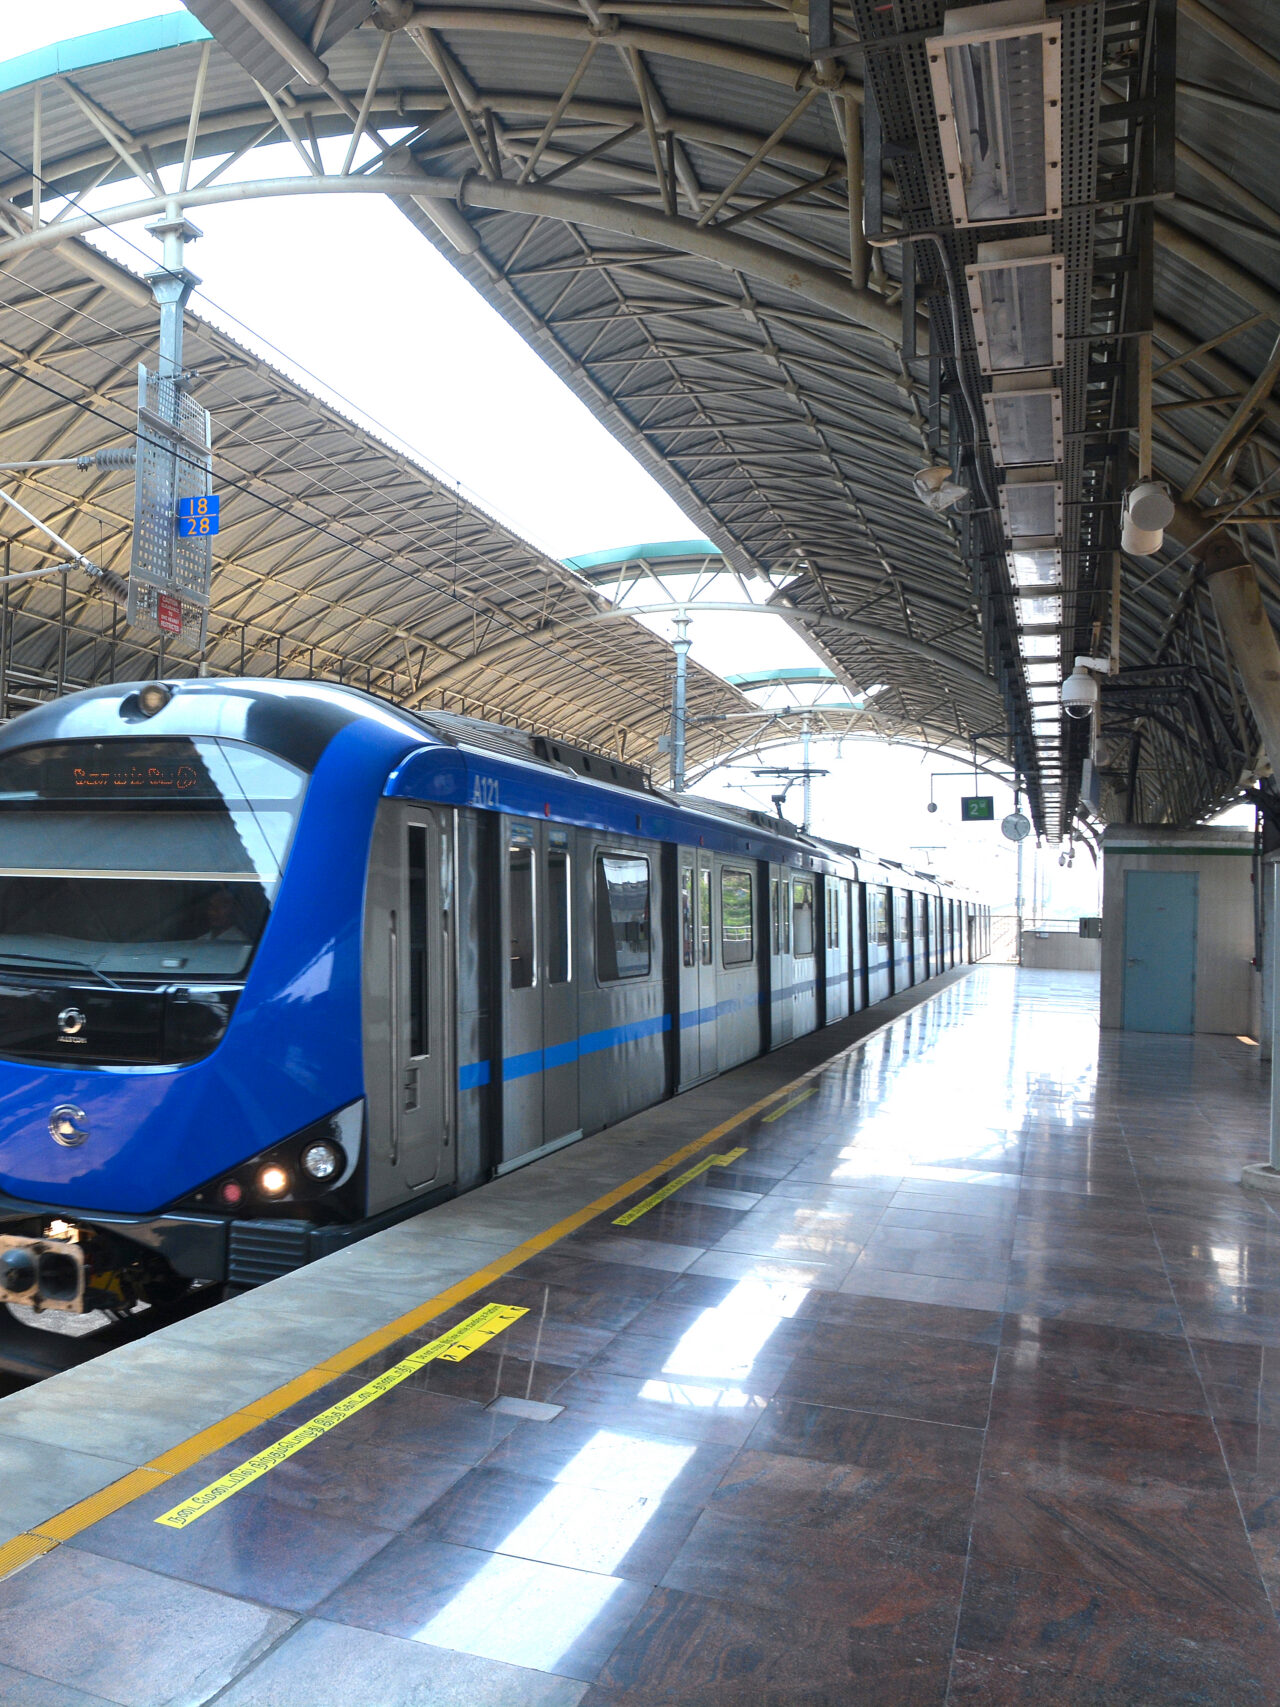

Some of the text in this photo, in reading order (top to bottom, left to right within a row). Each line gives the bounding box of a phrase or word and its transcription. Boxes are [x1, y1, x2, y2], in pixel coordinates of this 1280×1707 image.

[190, 498, 208, 515] 18
[188, 517, 210, 535] 28
[970, 803, 979, 815] 2
